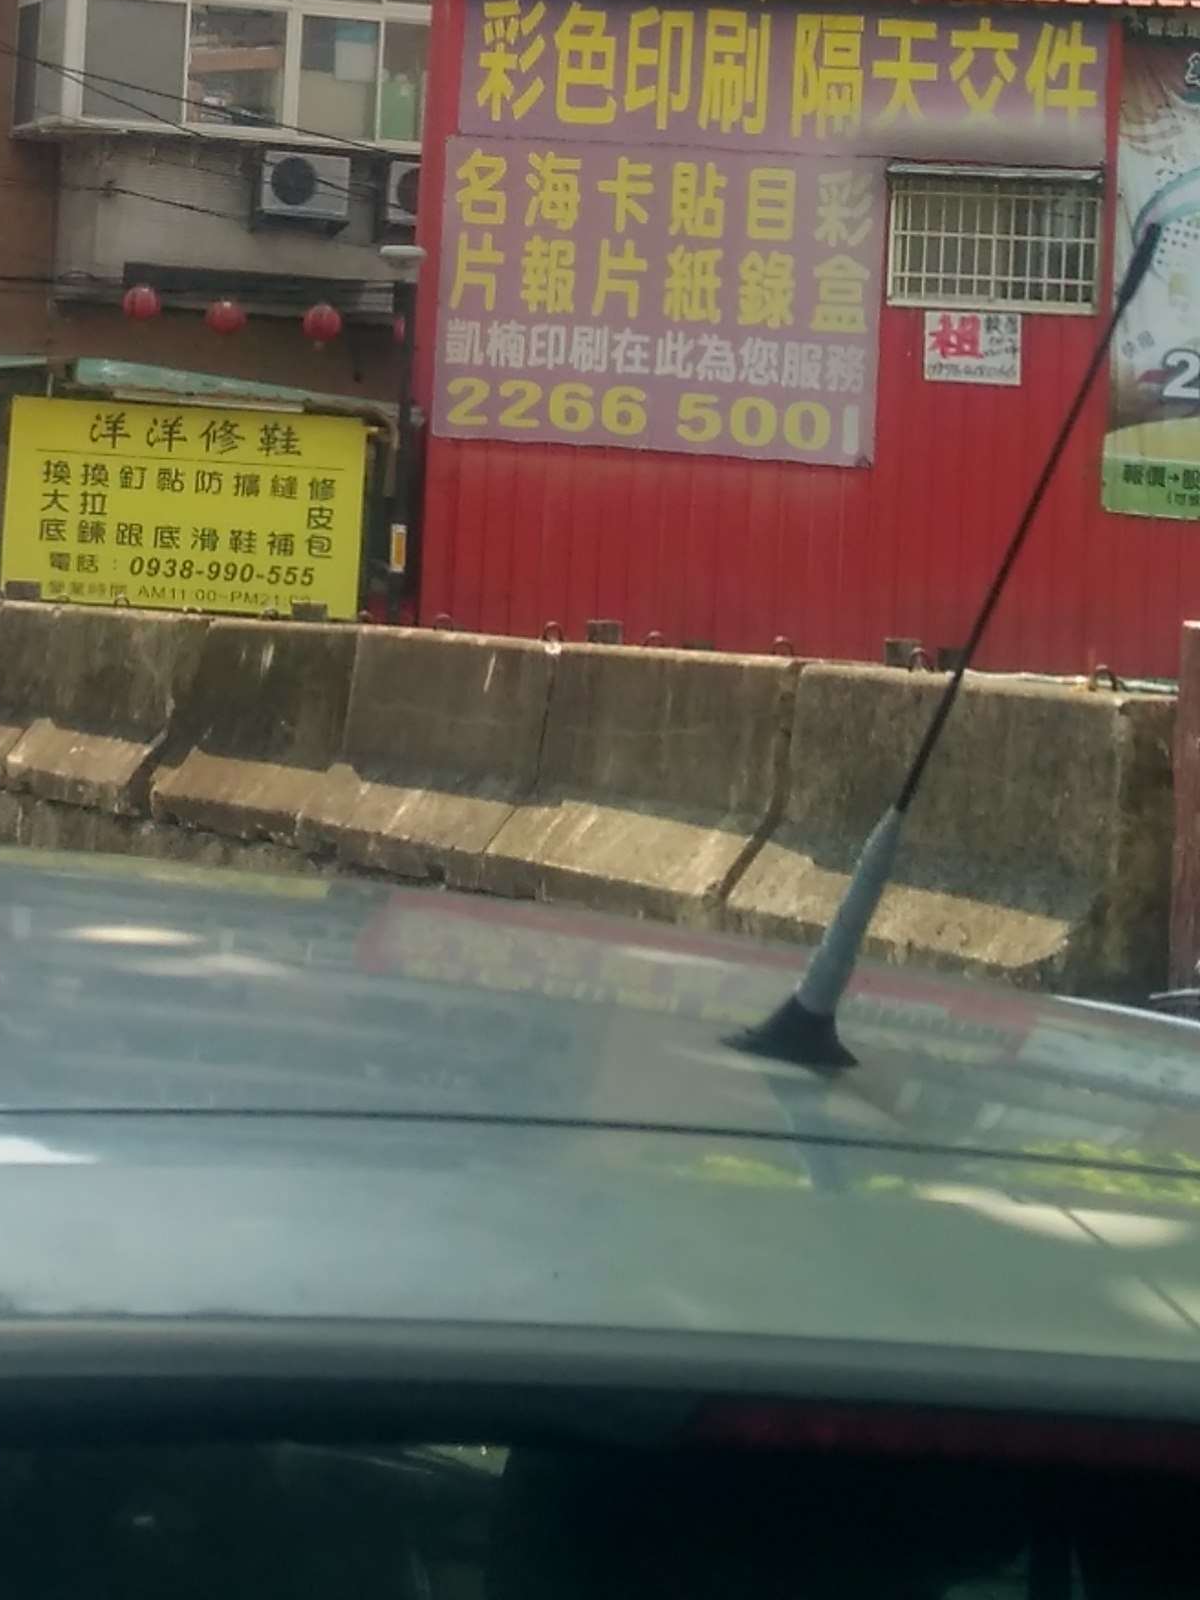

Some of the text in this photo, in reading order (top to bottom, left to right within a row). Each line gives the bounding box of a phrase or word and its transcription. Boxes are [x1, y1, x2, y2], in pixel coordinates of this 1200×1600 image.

[791, 13, 1099, 139] 隔天交件
[448, 148, 508, 311] 名片
[519, 151, 583, 318] 海報
[592, 155, 653, 320] 卡片
[663, 161, 728, 325] 貼紙
[737, 167, 798, 330] 目錄
[809, 169, 874, 335] 彩盒
[90, 412, 303, 457] 洋洋修鞋
[445, 319, 868, 395] 凱楠印刷在此為您服務
[447, 376, 861, 456] 2266 5001
[129, 556, 316, 587] 0938-990-555
